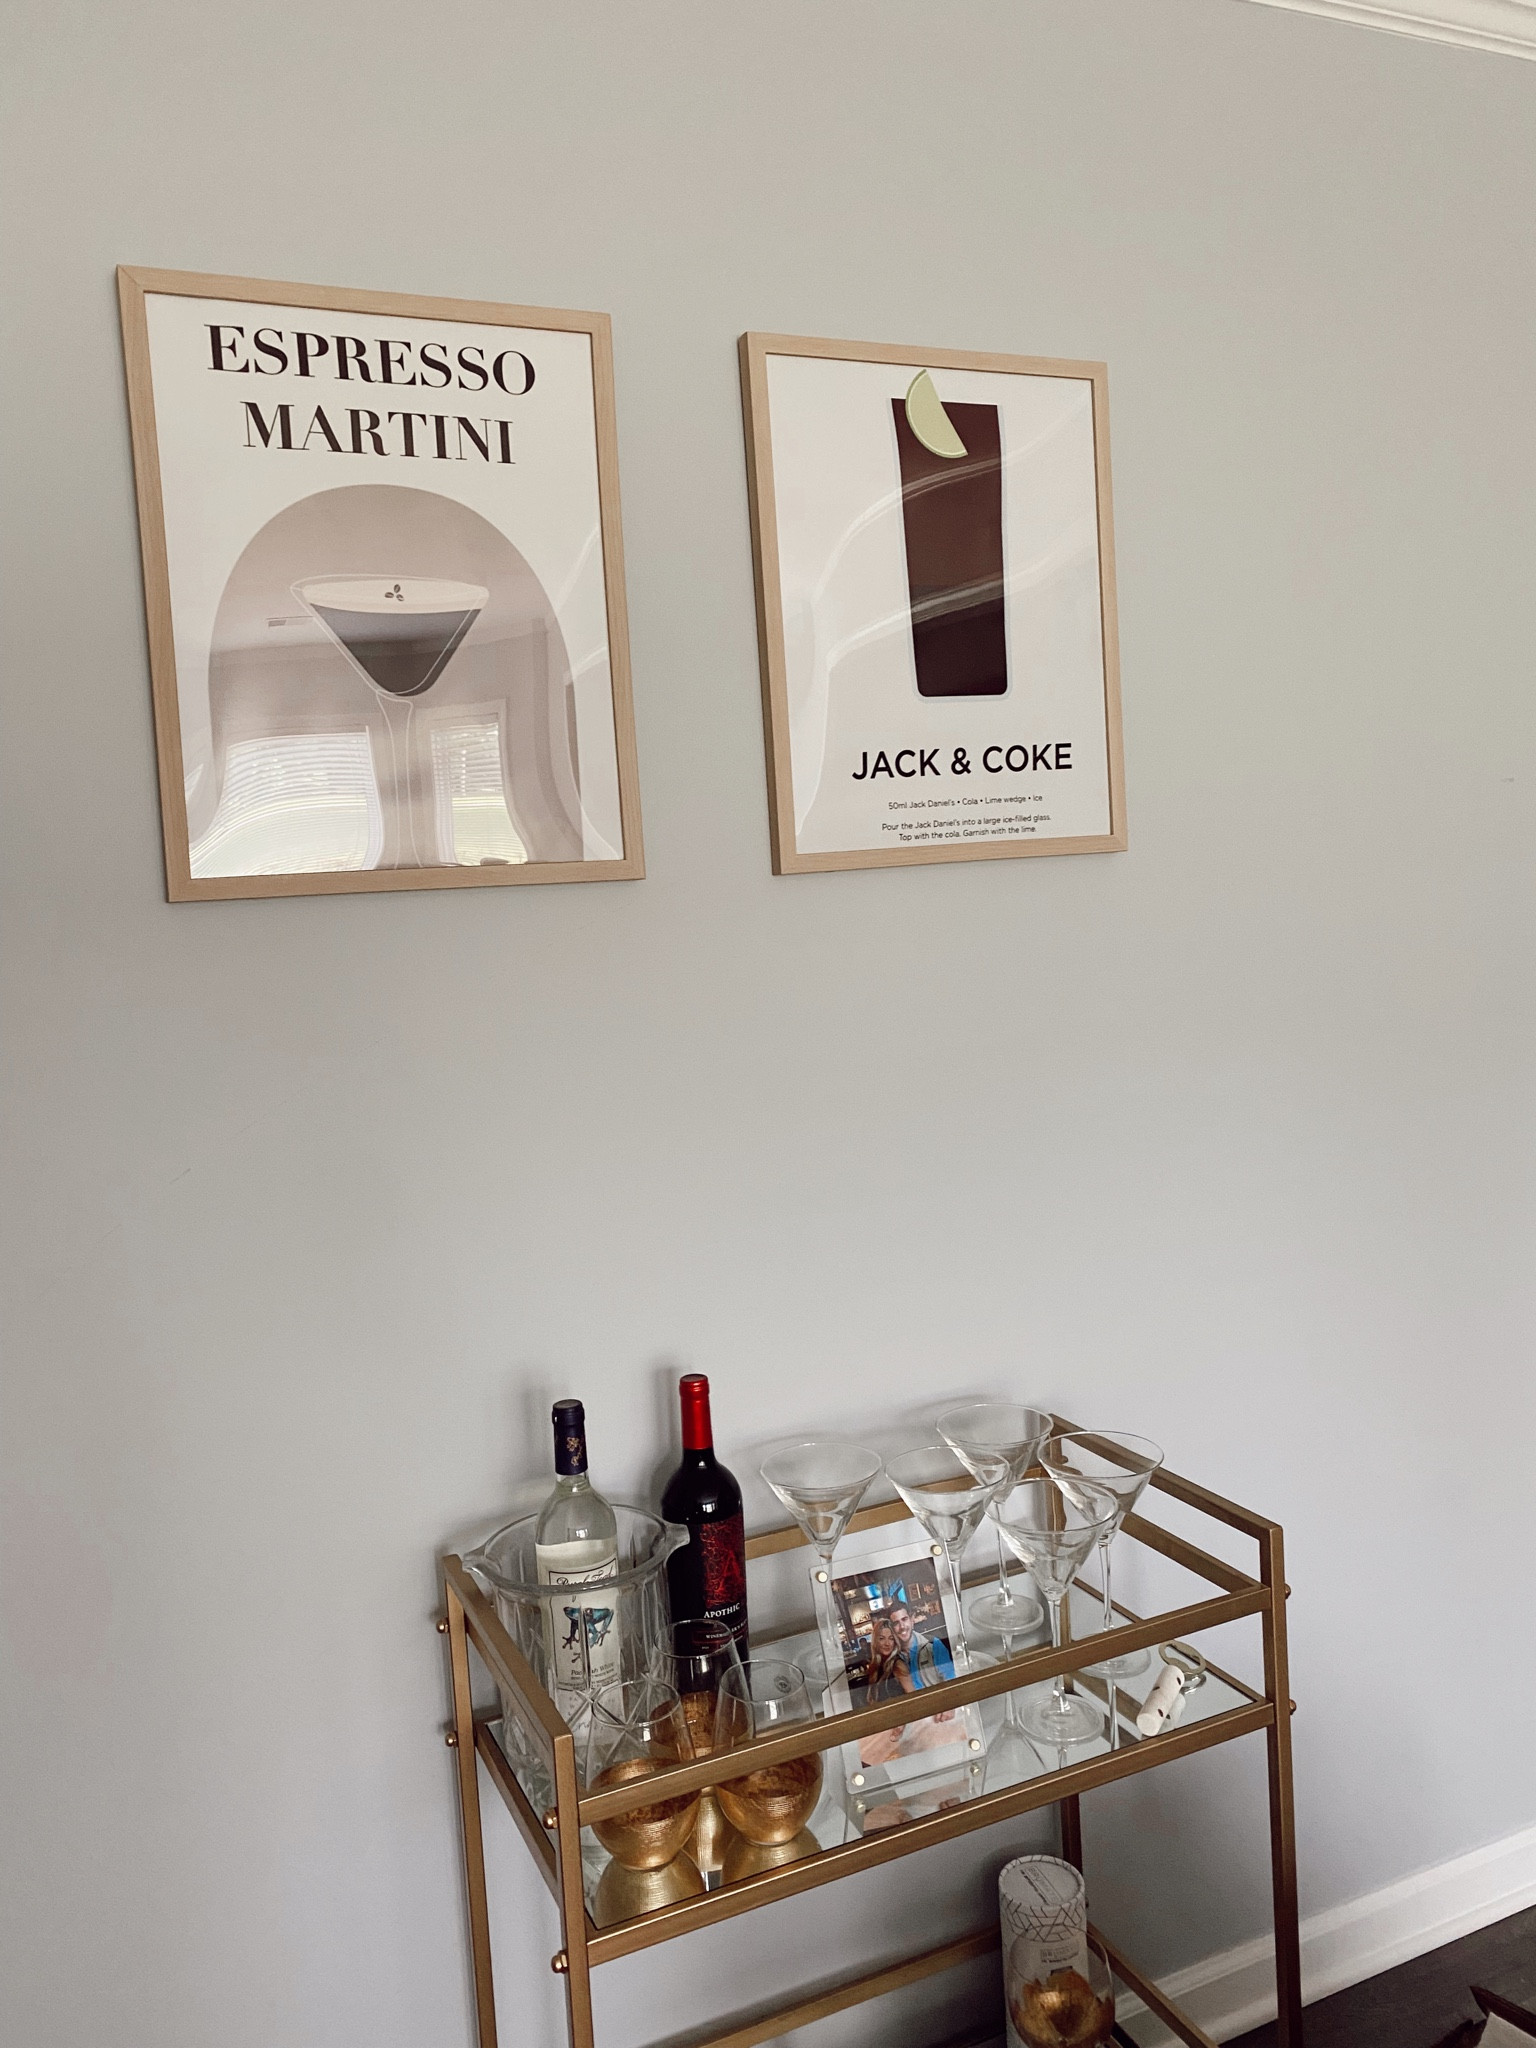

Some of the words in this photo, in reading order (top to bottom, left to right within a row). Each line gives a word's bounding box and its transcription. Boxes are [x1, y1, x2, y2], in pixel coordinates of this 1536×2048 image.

[204, 323, 537, 396] ESPRESSO
[239, 400, 517, 465] MARTINI
[851, 748, 941, 781] JACK
[950, 747, 971, 775] &
[982, 742, 1073, 774] COKE
[888, 800, 907, 810] 50ml
[909, 799, 926, 809] Jack
[928, 798, 955, 808] Daniel's
[962, 797, 978, 806] Cola
[985, 796, 1002, 804] Lime
[1004, 795, 1026, 805] wedge
[1033, 794, 1043, 802] Ice
[882, 823, 899, 831] Pour
[901, 822, 913, 830] the
[914, 821, 931, 829] Jack
[933, 819, 960, 828] Daniel's
[962, 818, 975, 826] into
[983, 817, 1001, 826] large
[1002, 815, 1032, 824] ice-filled
[1033, 814, 1052, 823] glass.
[899, 833, 912, 842] Top
[914, 832, 930, 840] with
[944, 830, 961, 838] cola.
[963, 828, 990, 837] Garnish
[991, 828, 1006, 836] with
[1008, 826, 1020, 834] the
[703, 1602, 740, 1619] APOTHIC
